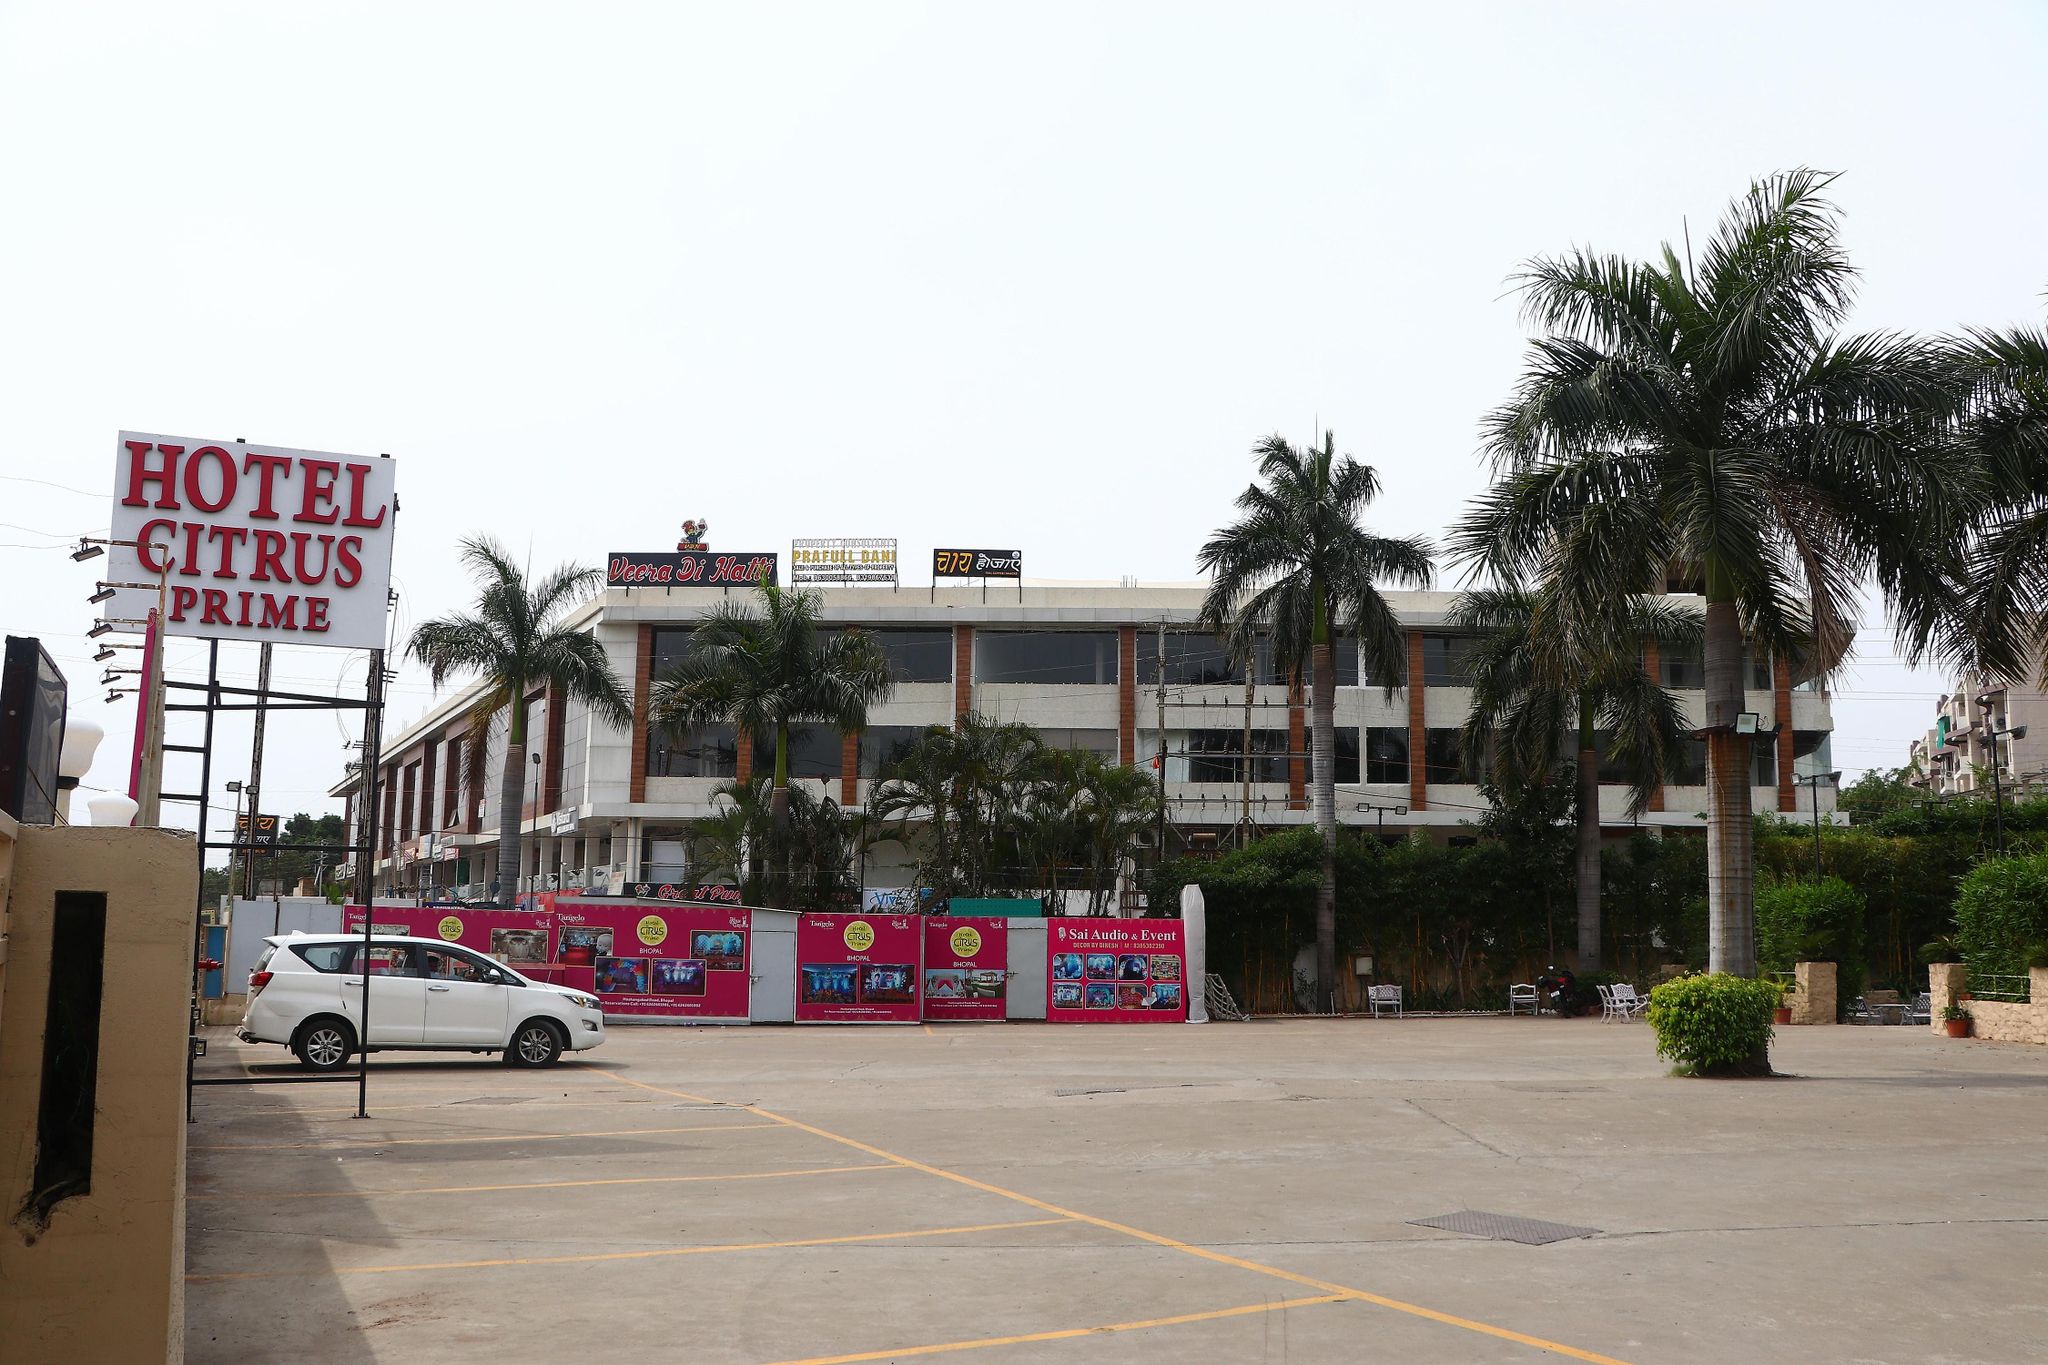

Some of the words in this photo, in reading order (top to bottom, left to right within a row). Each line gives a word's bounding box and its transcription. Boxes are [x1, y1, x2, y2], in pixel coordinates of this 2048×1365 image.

[122, 440, 387, 528] HOTEL
[137, 518, 363, 588] CITRUS
[793, 550, 855, 563] PRAFULL
[608, 557, 673, 582] Veera
[676, 556, 706, 582] Di
[709, 556, 775, 582] Hatti
[936, 552, 973, 573] चाय
[168, 585, 331, 632] PRIME
[348, 913, 367, 921] Tangel
[556, 913, 586, 923] Tangelo
[1069, 928, 1088, 941] Sai
[1091, 928, 1129, 941] Audio
[1131, 933, 1138, 941] &
[1140, 929, 1177, 941] Event
[639, 947, 664, 955] BHOPAL
